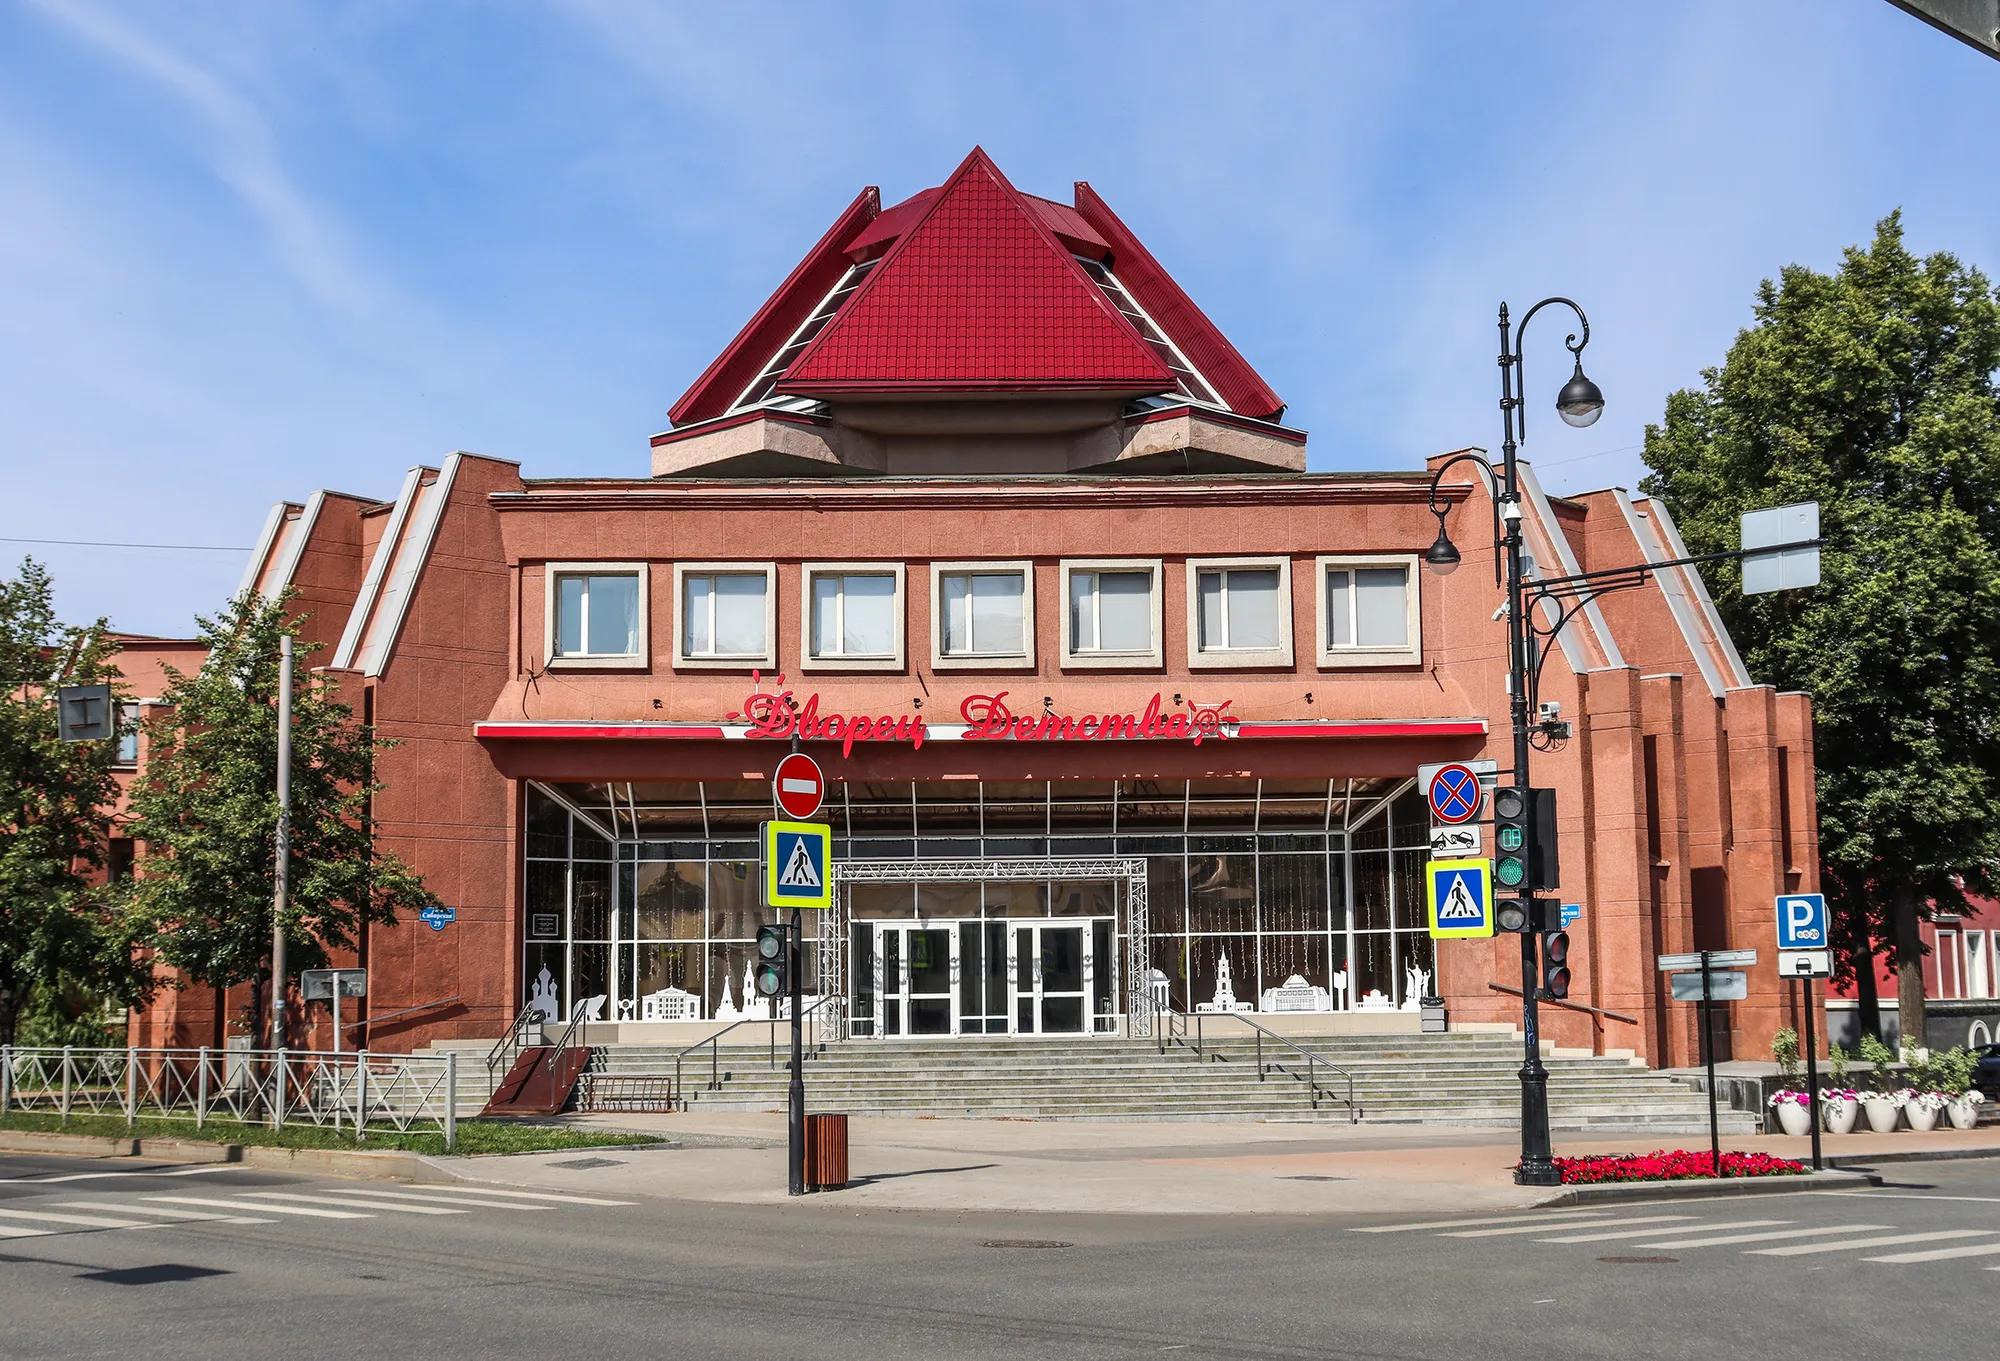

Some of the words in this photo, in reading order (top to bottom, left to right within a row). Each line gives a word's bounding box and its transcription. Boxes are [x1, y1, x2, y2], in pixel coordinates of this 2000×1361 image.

[744, 691, 927, 759] Дворец
[1502, 829, 1521, 846] 08
[1787, 899, 1814, 941] P
